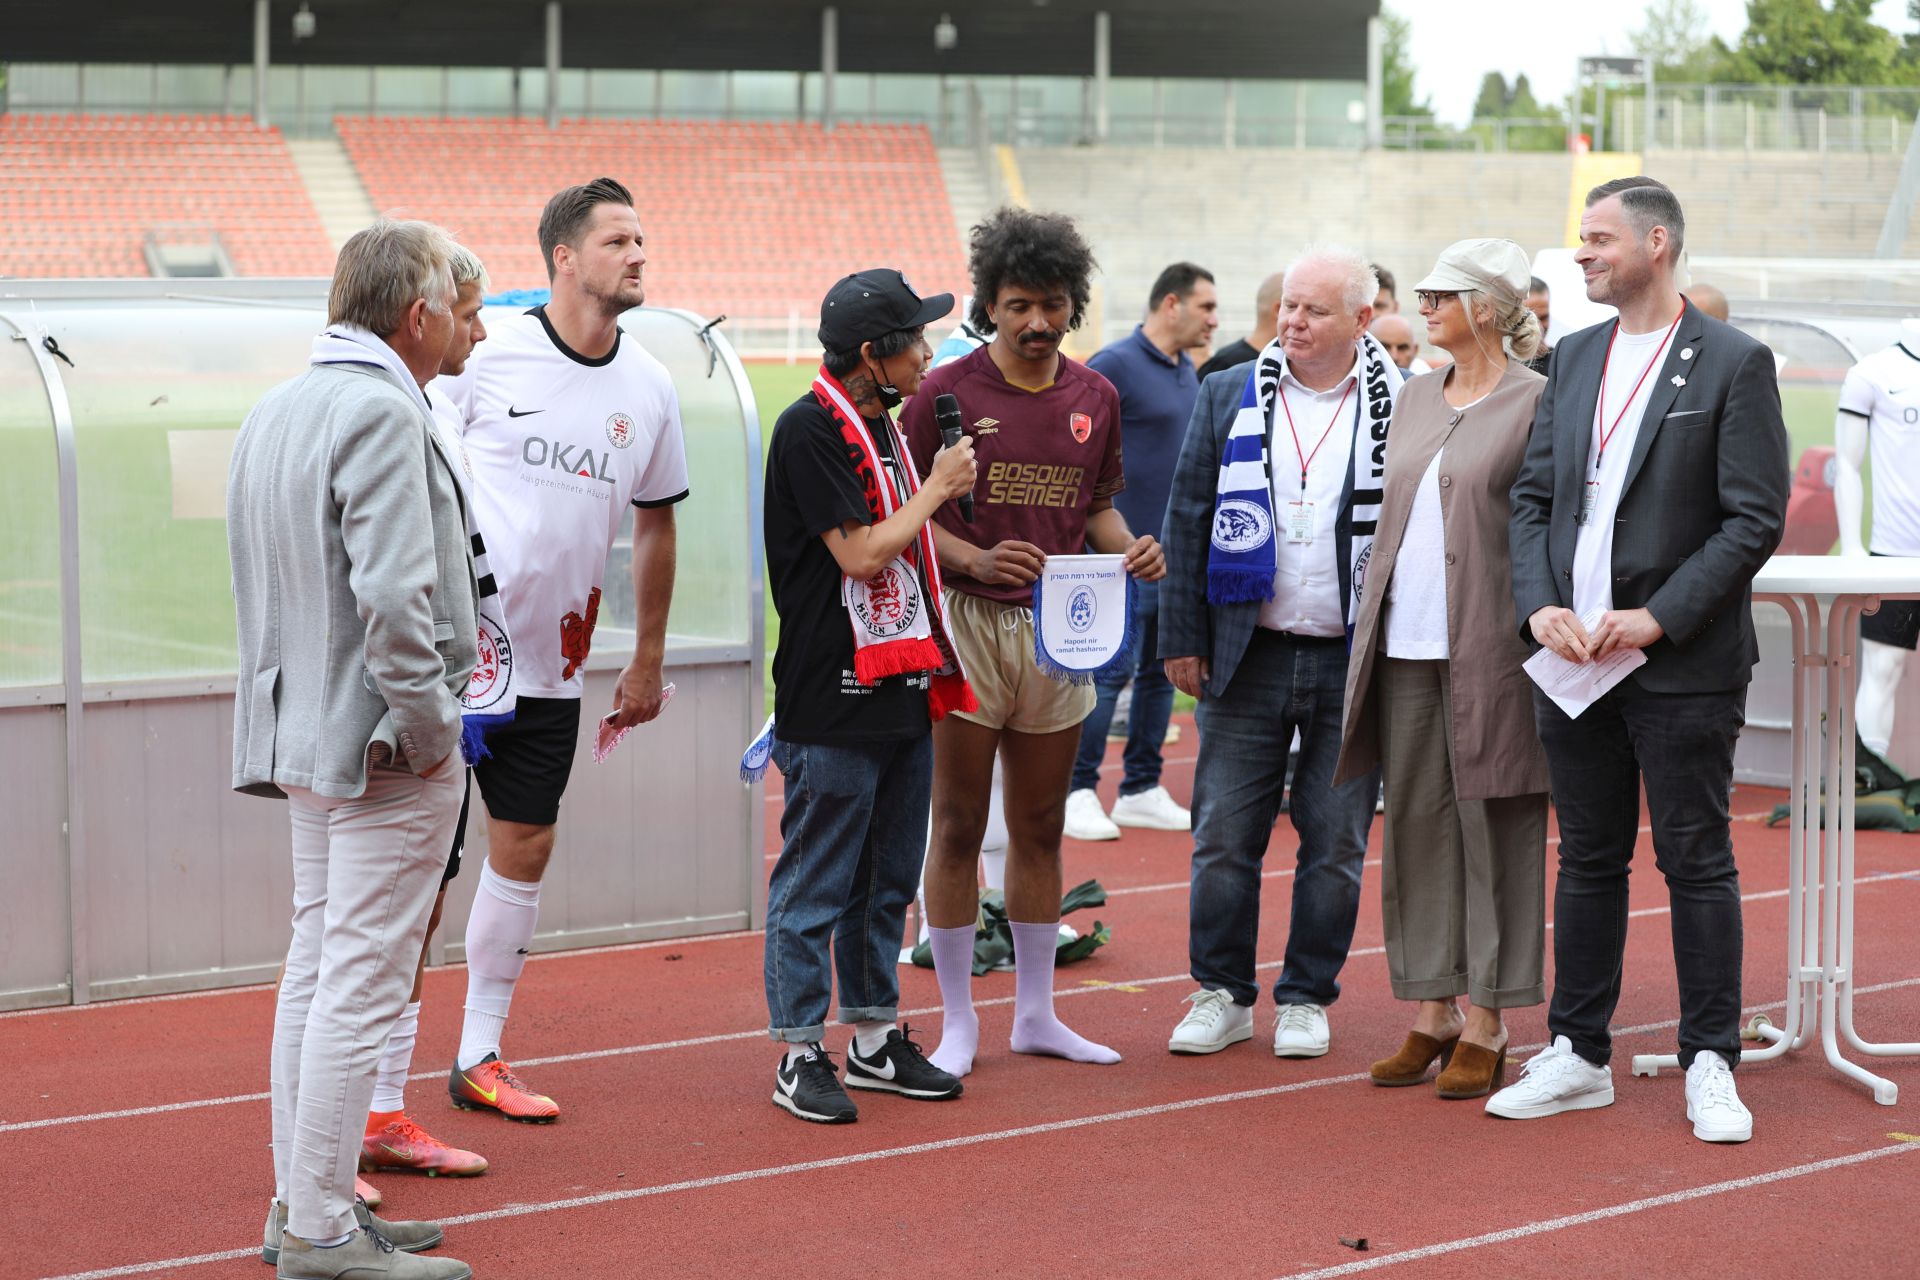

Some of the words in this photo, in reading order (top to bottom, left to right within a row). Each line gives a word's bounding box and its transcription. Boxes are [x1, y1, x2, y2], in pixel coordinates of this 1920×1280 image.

[977, 427, 999, 435] umbro
[522, 436, 616, 485] OKAL
[520, 473, 583, 495] Ausgezeichnete
[986, 461, 1086, 487] BOSOWA
[986, 481, 1080, 508] SEMEN
[895, 592, 918, 632] KASSEL
[494, 636, 510, 667] KSV
[1064, 638, 1087, 646] Hapoel
[842, 669, 853, 678] We
